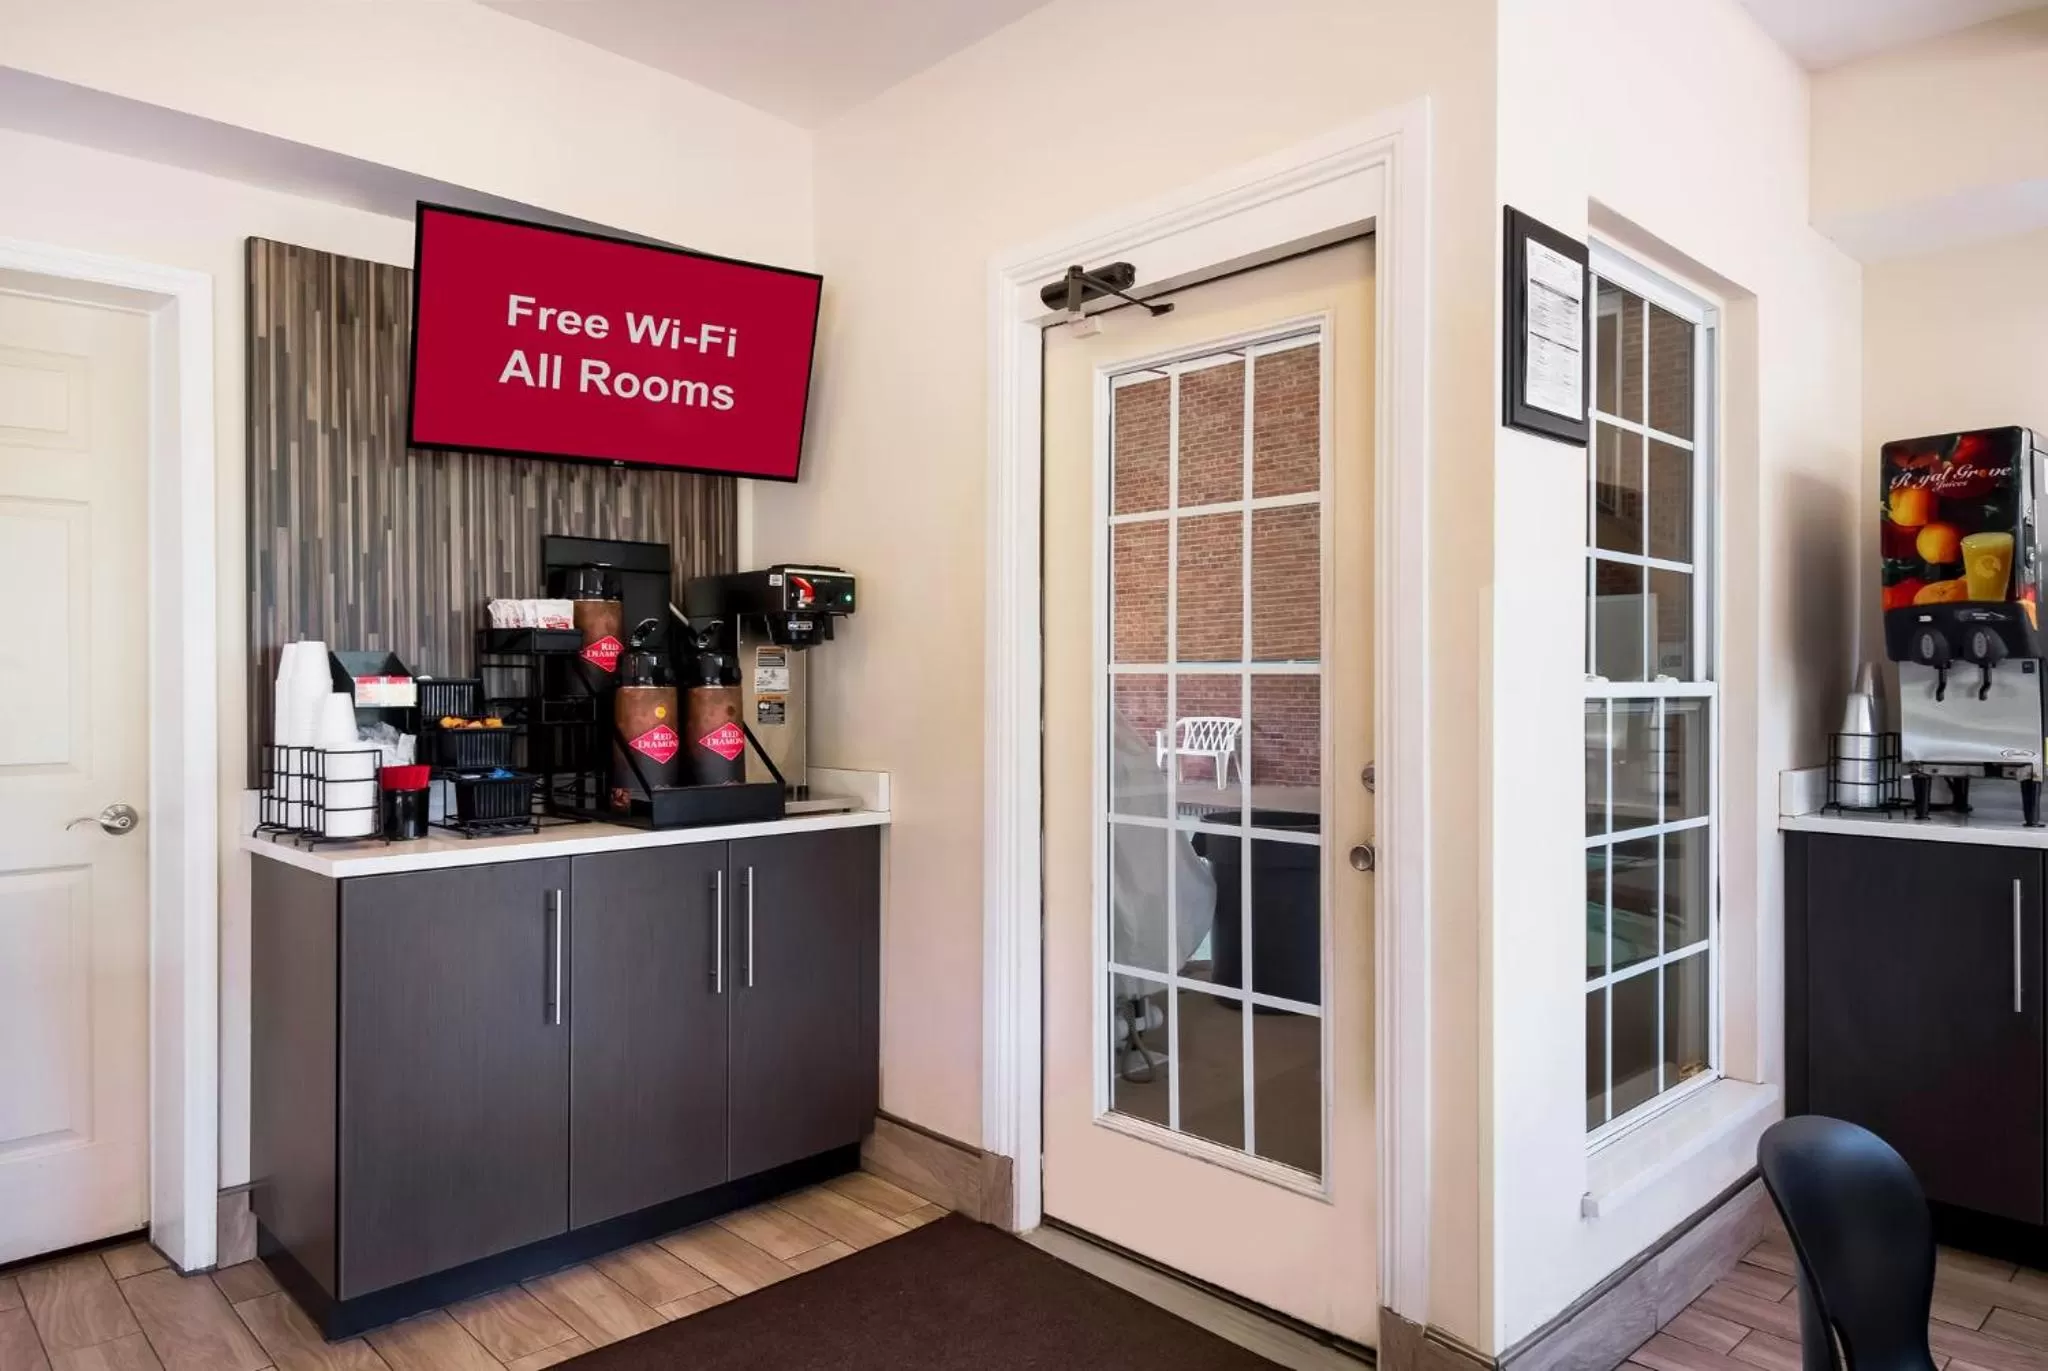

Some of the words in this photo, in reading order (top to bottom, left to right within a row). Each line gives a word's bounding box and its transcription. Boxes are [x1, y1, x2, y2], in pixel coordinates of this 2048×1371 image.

[507, 294, 610, 340] Free
[625, 311, 738, 358] Wi-Fi
[498, 349, 563, 390] All
[579, 358, 735, 411] Rooms
[1889, 467, 1953, 490] Ryal
[653, 732, 672, 740] RED
[720, 730, 738, 738] RED
